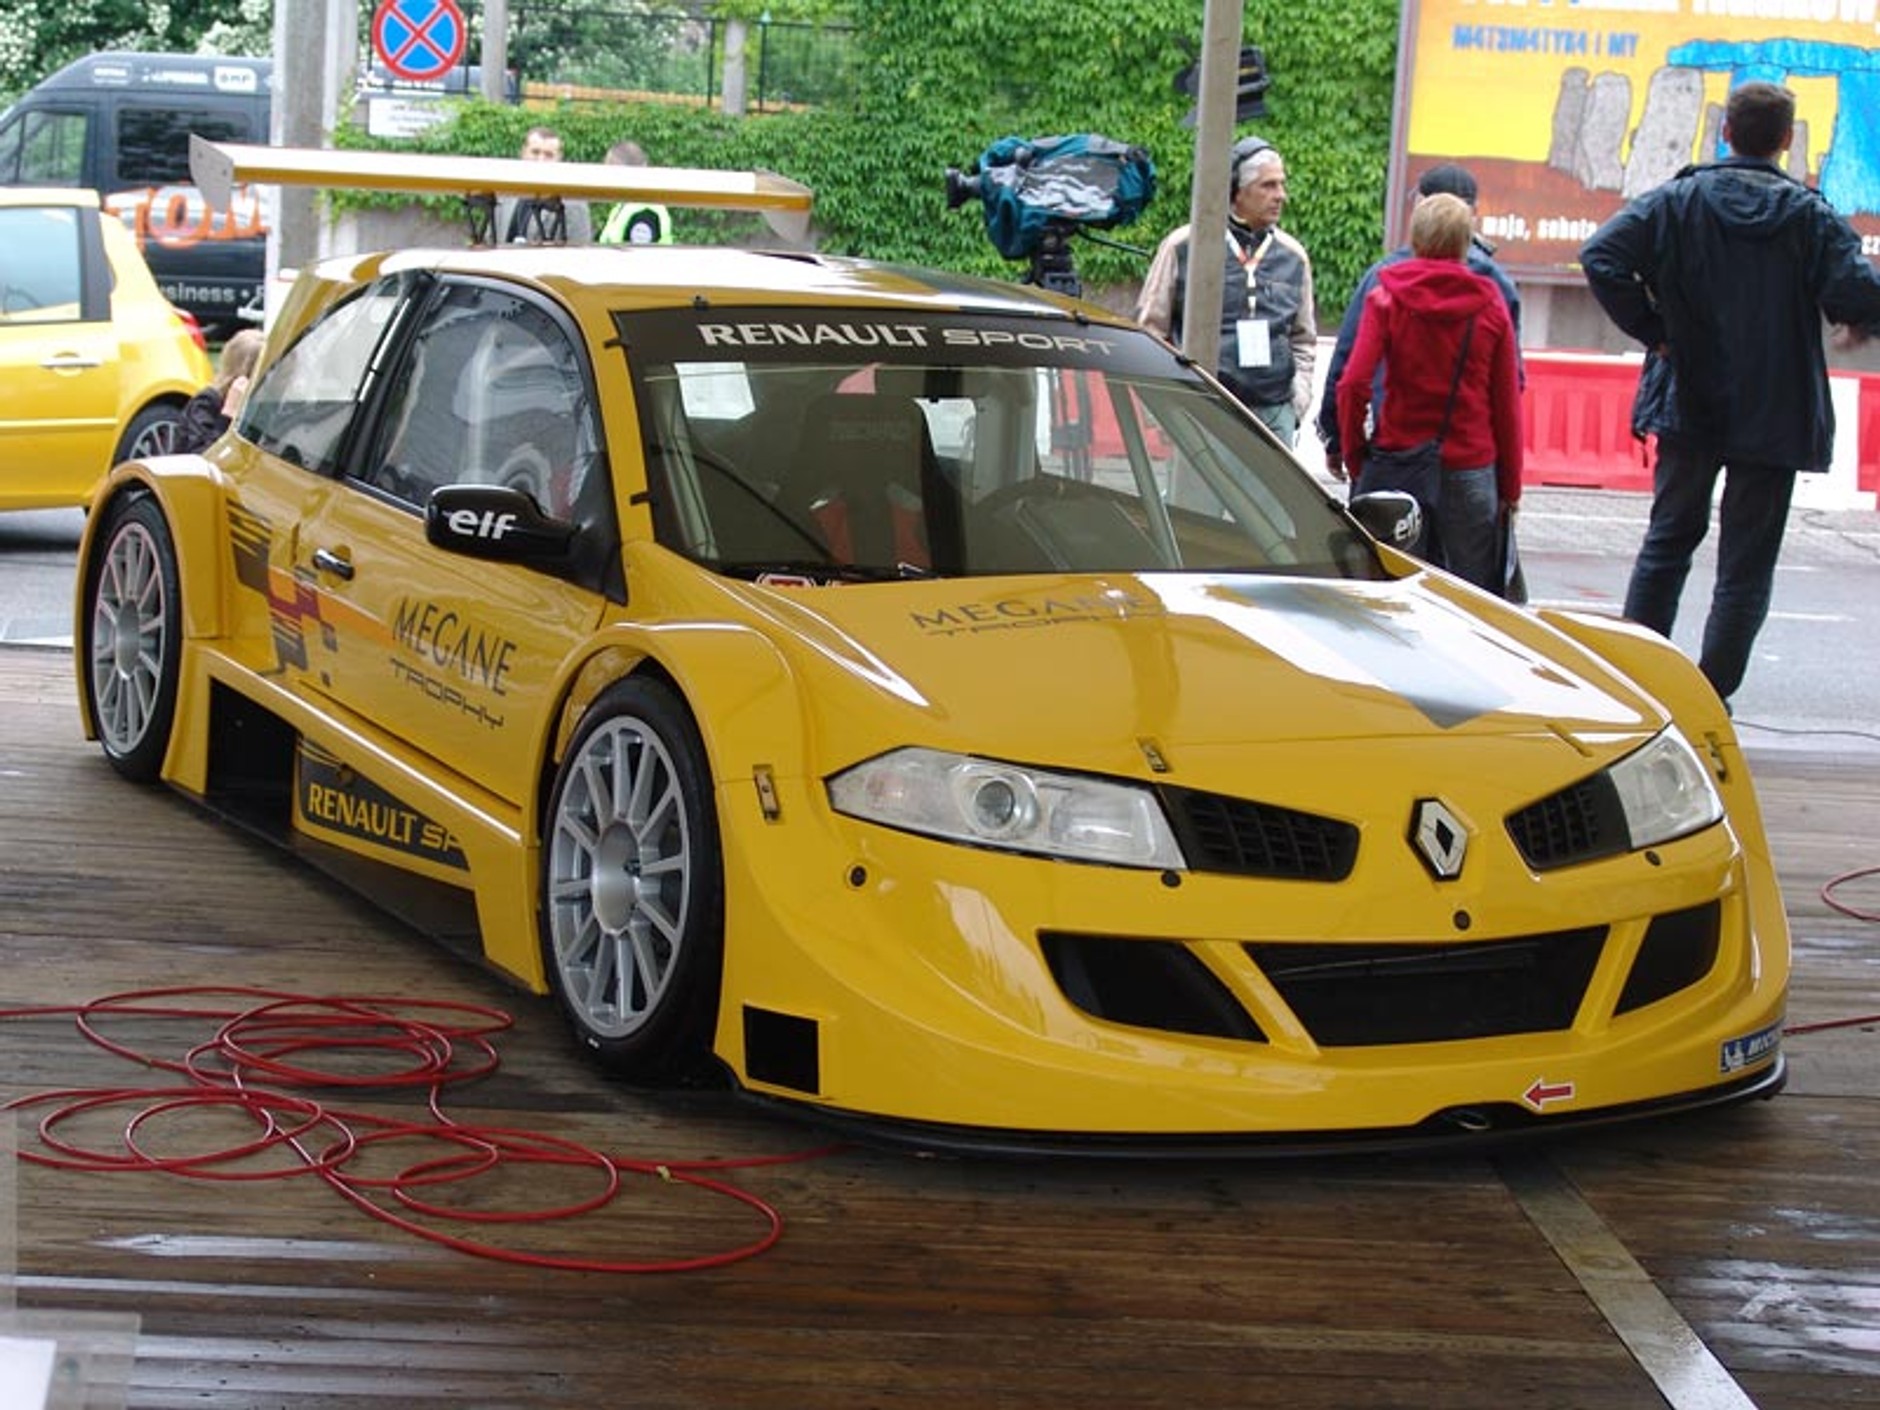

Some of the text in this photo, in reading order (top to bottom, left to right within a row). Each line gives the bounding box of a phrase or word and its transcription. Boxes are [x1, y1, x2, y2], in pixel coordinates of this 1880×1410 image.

[1607, 32, 1640, 57] MY
[160, 282, 236, 303] siness
[697, 322, 1118, 356] RENAULT SPORT
[447, 508, 517, 540] elf
[391, 594, 517, 697] MEGANE
[389, 656, 505, 731] TROPHY
[308, 781, 418, 844] RENAULT
